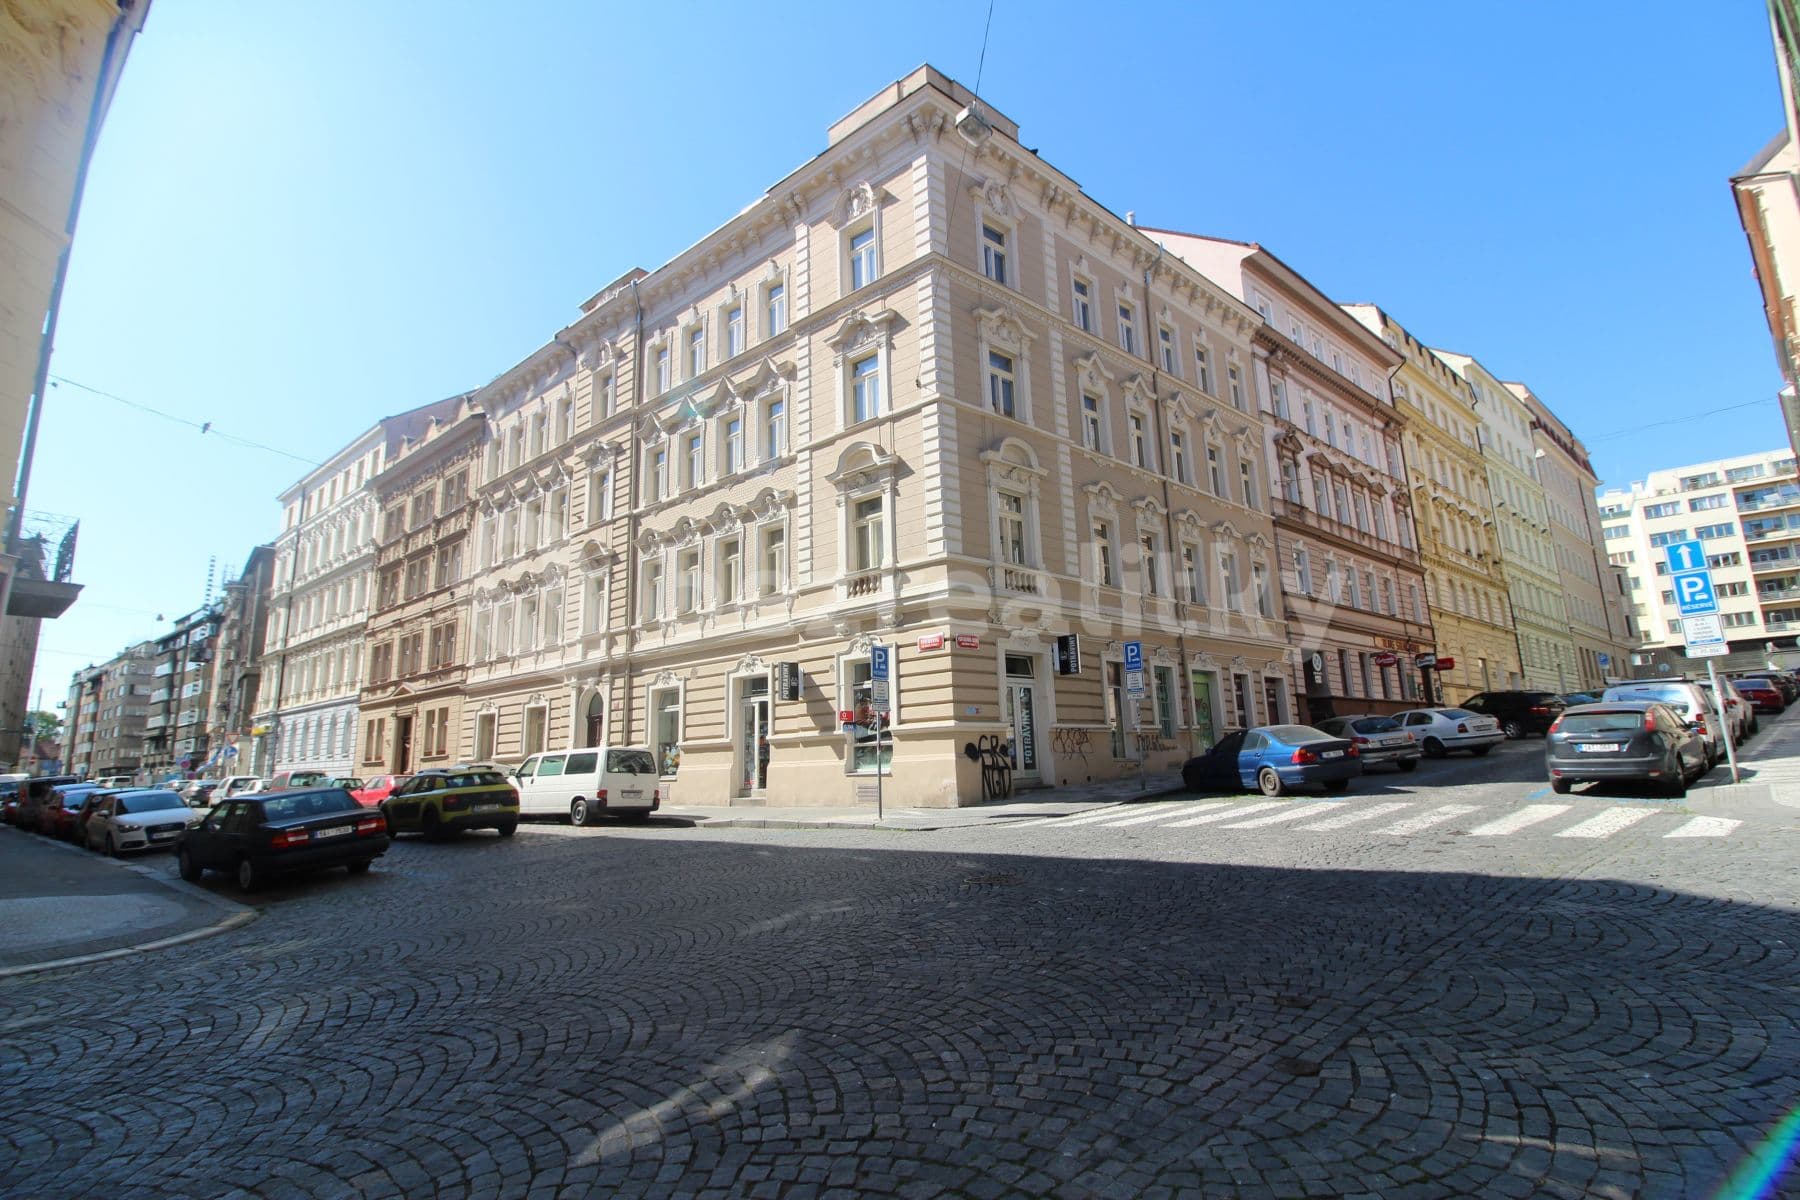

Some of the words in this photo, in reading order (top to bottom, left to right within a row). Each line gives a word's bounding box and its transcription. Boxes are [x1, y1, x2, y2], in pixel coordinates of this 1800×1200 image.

[1680, 577, 1704, 602] P
[875, 650, 885, 669] P
[1069, 637, 1077, 672] POTRAVINY
[1127, 645, 1137, 662] P
[782, 663, 790, 699] POTRAVINY
[1022, 709, 1033, 764] POTRAVINY
